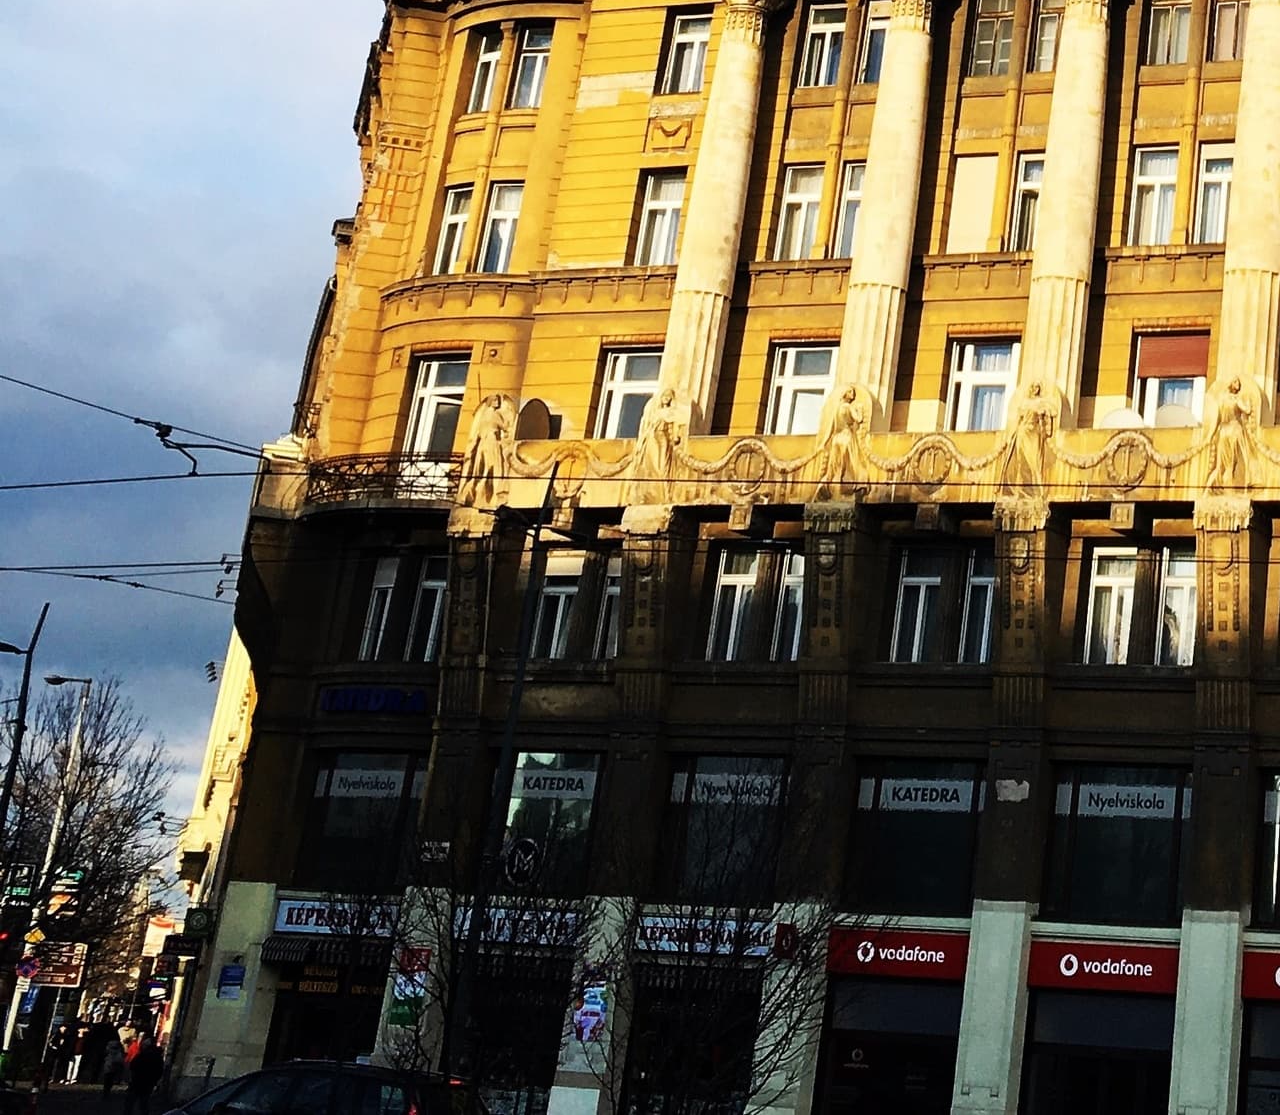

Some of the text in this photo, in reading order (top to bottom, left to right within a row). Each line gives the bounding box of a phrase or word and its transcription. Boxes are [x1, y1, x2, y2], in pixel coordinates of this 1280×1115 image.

[337, 776, 396, 794] Nyelviskola
[522, 776, 586, 793] KATEDRA
[891, 785, 961, 805] KATEDRA
[1087, 791, 1166, 813] Nyelviskola
[879, 945, 945, 964] vodafone
[1083, 959, 1153, 978] vodafone
